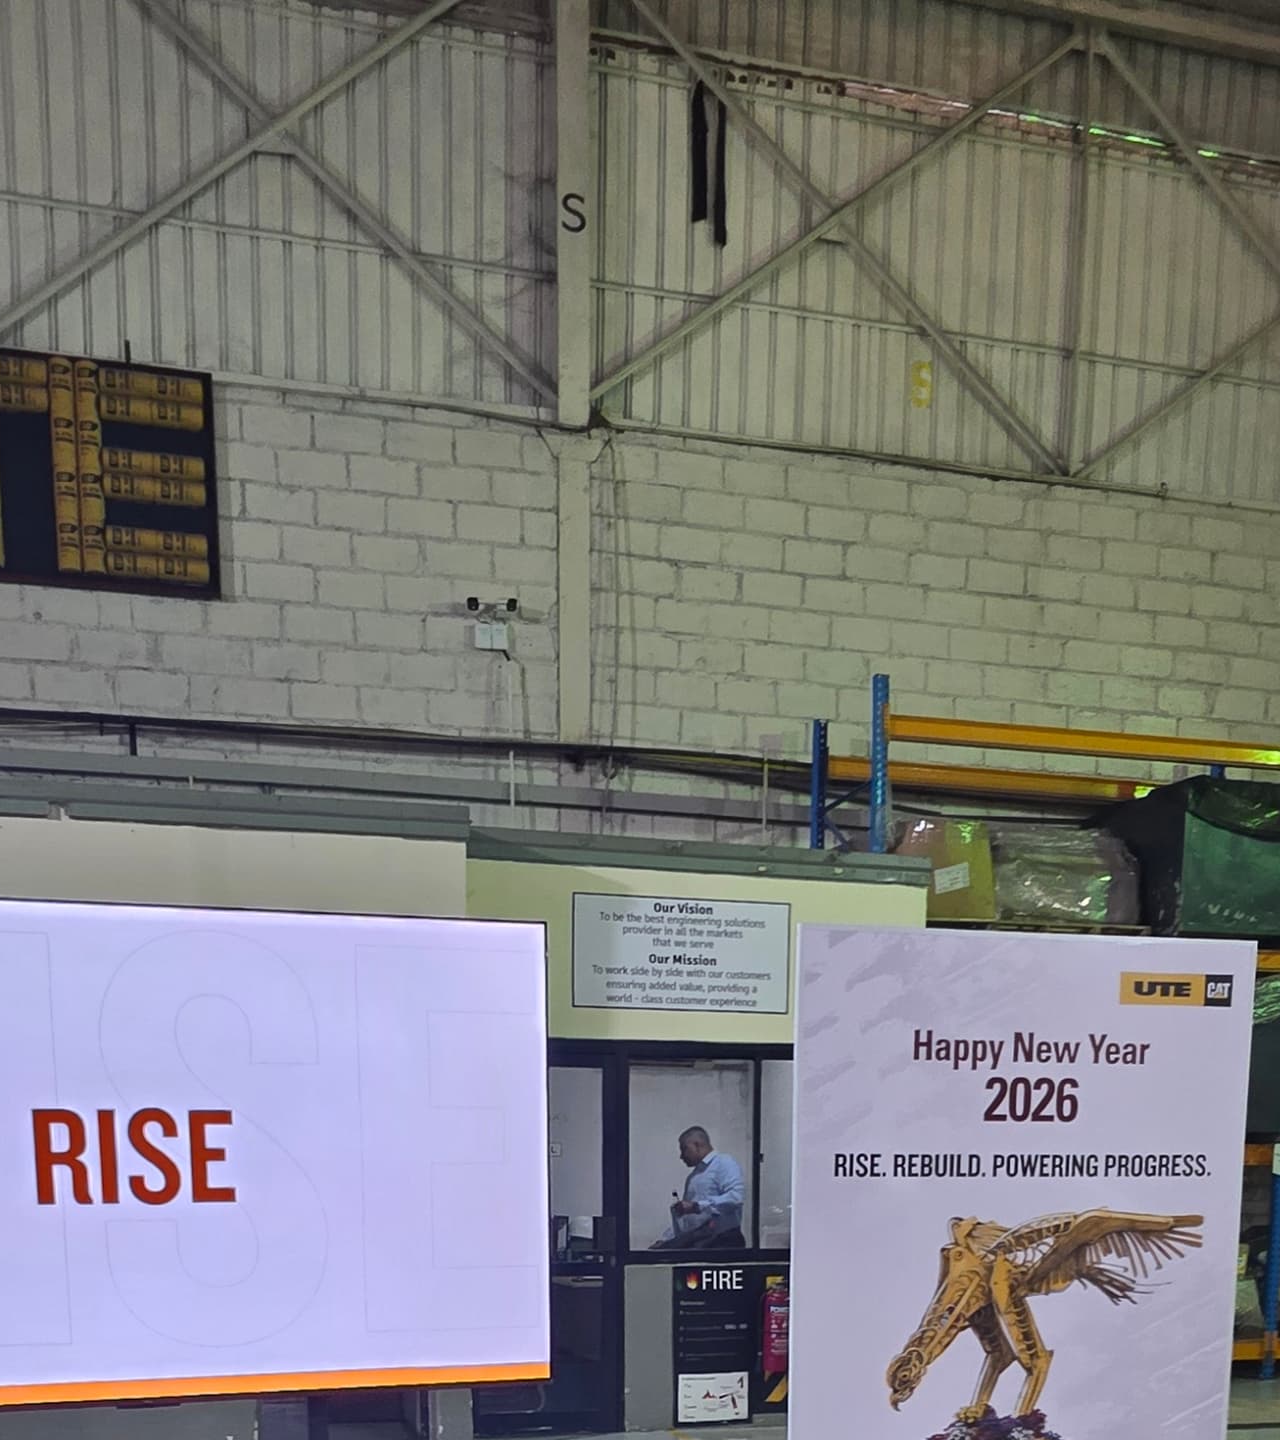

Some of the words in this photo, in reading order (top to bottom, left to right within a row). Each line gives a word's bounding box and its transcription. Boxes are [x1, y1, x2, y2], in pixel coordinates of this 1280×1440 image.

[560, 192, 587, 234] S
[653, 902, 675, 914] Our
[677, 902, 714, 915] Vision
[600, 911, 611, 921] To
[612, 912, 624, 921] be
[626, 913, 642, 923] the
[644, 914, 664, 923] best
[666, 915, 722, 928] engineering
[724, 918, 766, 928] solutions
[622, 926, 662, 936] provider
[664, 926, 673, 936] in
[675, 927, 687, 937] all
[689, 928, 704, 937] the
[706, 929, 744, 939] markets
[652, 938, 672, 947] that
[673, 940, 687, 948] we
[648, 953, 670, 964] Our
[672, 953, 717, 966] Mission
[592, 964, 603, 975] To
[605, 966, 629, 975] work
[630, 966, 650, 976] side
[651, 967, 664, 978] by
[665, 967, 685, 977] side
[686, 969, 706, 978] with
[725, 971, 771, 980] customers
[606, 981, 646, 992] ensuring
[648, 981, 677, 990] added
[707, 983, 750, 996] providing
[1133, 981, 1192, 997] UTE
[1206, 982, 1231, 999] CAT
[606, 993, 633, 1003] world
[641, 994, 663, 1004] class
[665, 996, 707, 1005] customer
[709, 997, 757, 1007] experience
[913, 1029, 1005, 1071] Happy
[1012, 1031, 1081, 1064] New
[1088, 1033, 1151, 1065] Year
[983, 1076, 1080, 1123] 2026
[31, 1107, 238, 1207] RISE
[833, 1153, 887, 1178] RISE.
[892, 1154, 986, 1178] REBUILD.
[991, 1154, 1099, 1178] POWERING
[1103, 1154, 1212, 1178] PROGRESS.
[701, 1269, 744, 1291] FIRE
